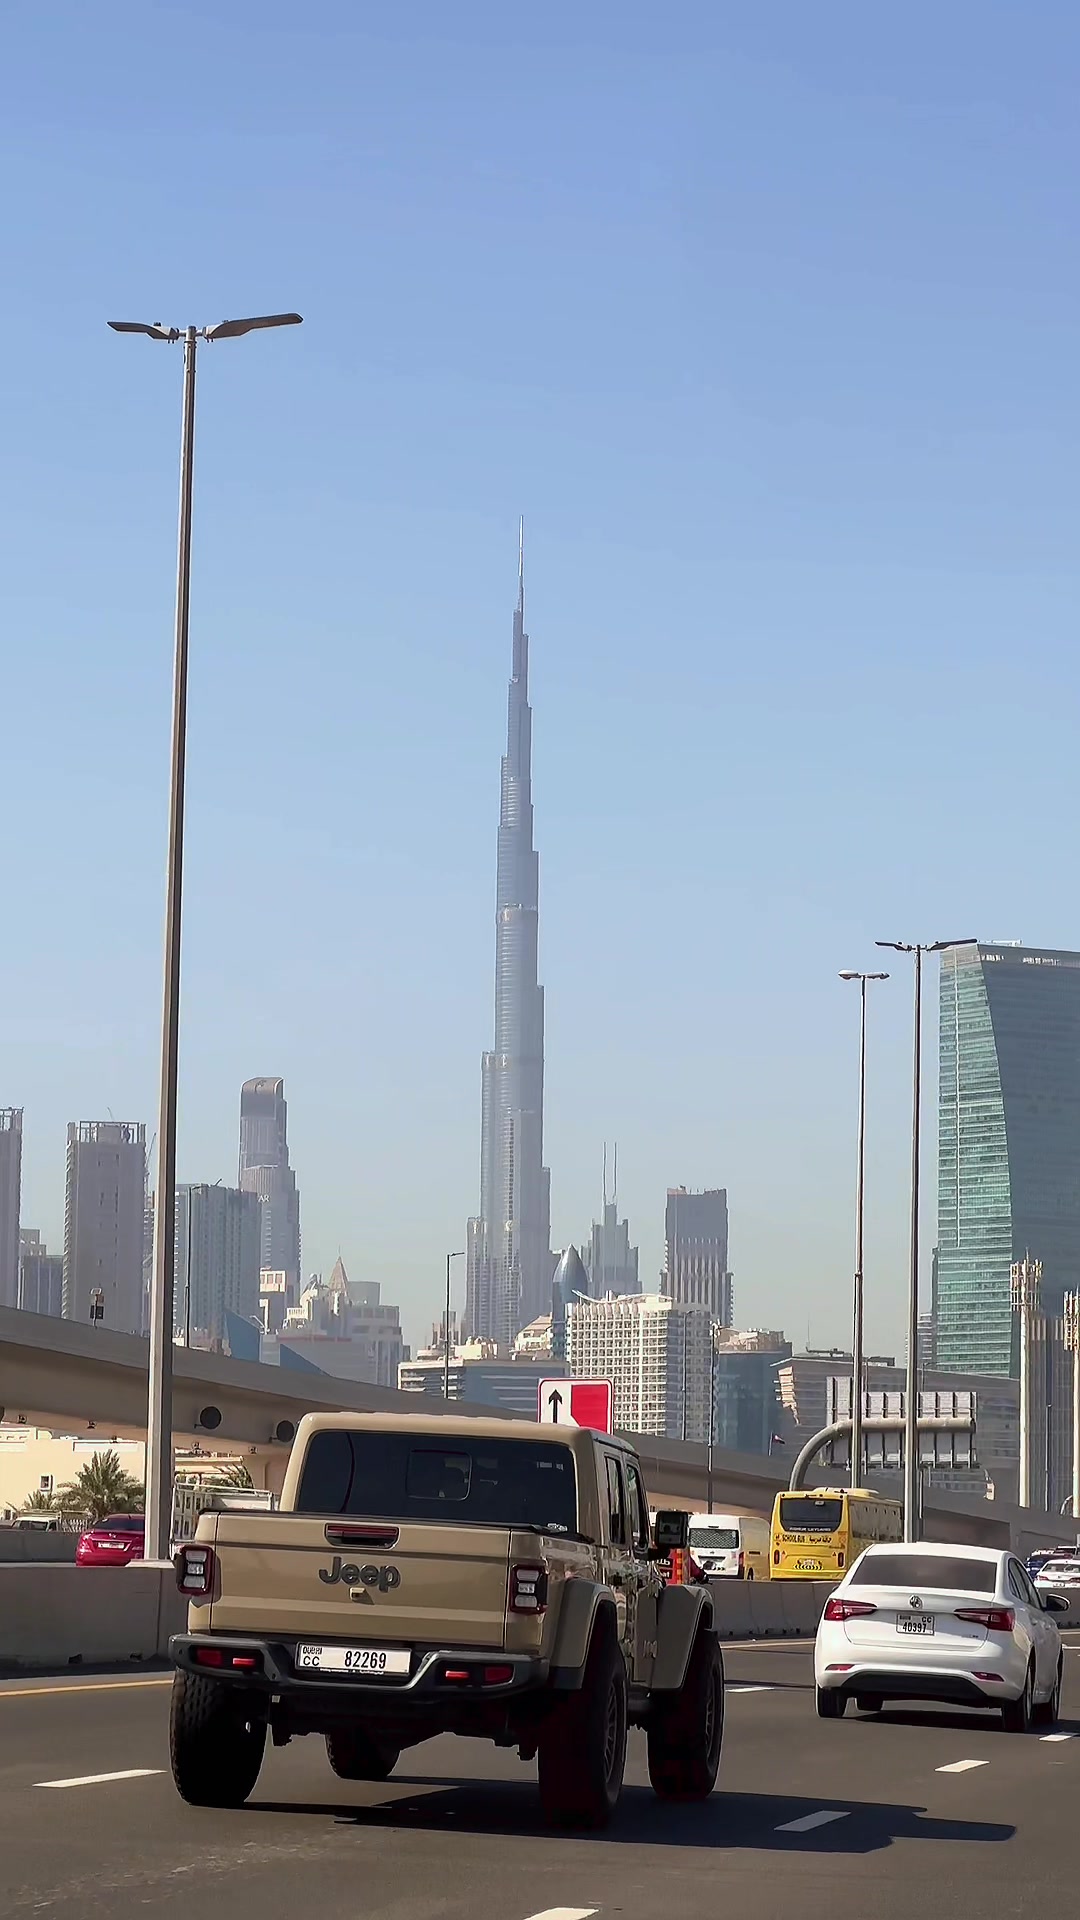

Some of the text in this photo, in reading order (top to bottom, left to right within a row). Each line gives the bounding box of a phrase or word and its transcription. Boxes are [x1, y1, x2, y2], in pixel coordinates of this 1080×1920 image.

[318, 1556, 401, 1593] Jeep
[903, 1622, 926, 1632] 40397
[303, 1655, 320, 1666] CC
[344, 1651, 387, 1669] 82269
